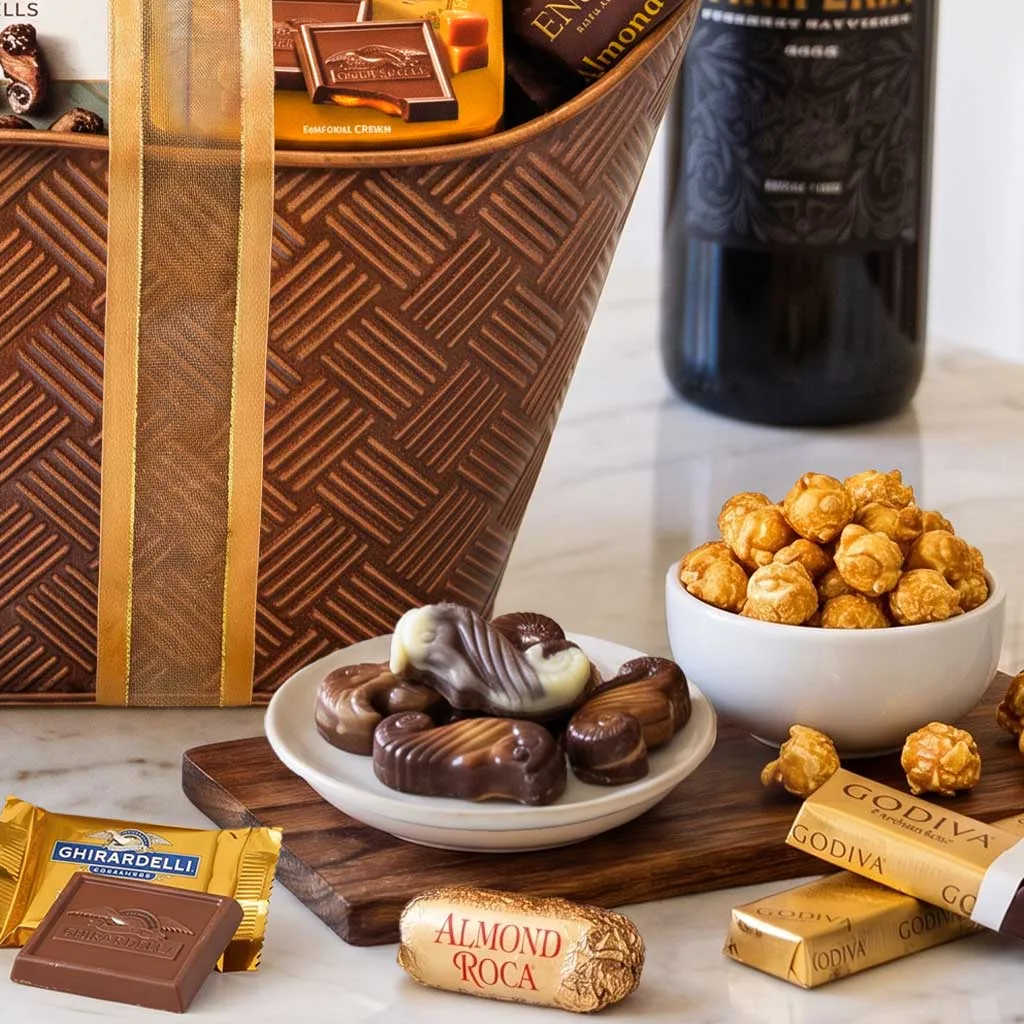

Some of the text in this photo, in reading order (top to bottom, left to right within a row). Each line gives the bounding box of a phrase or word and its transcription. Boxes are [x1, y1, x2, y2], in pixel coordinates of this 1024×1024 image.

[842, 783, 990, 849] GODIVA
[58, 846, 193, 874] GHIRARDELLI
[792, 824, 885, 875] GODIVA
[434, 912, 563, 958] ALMOND
[756, 906, 852, 932] GODIVA
[452, 950, 539, 991] ROCA
